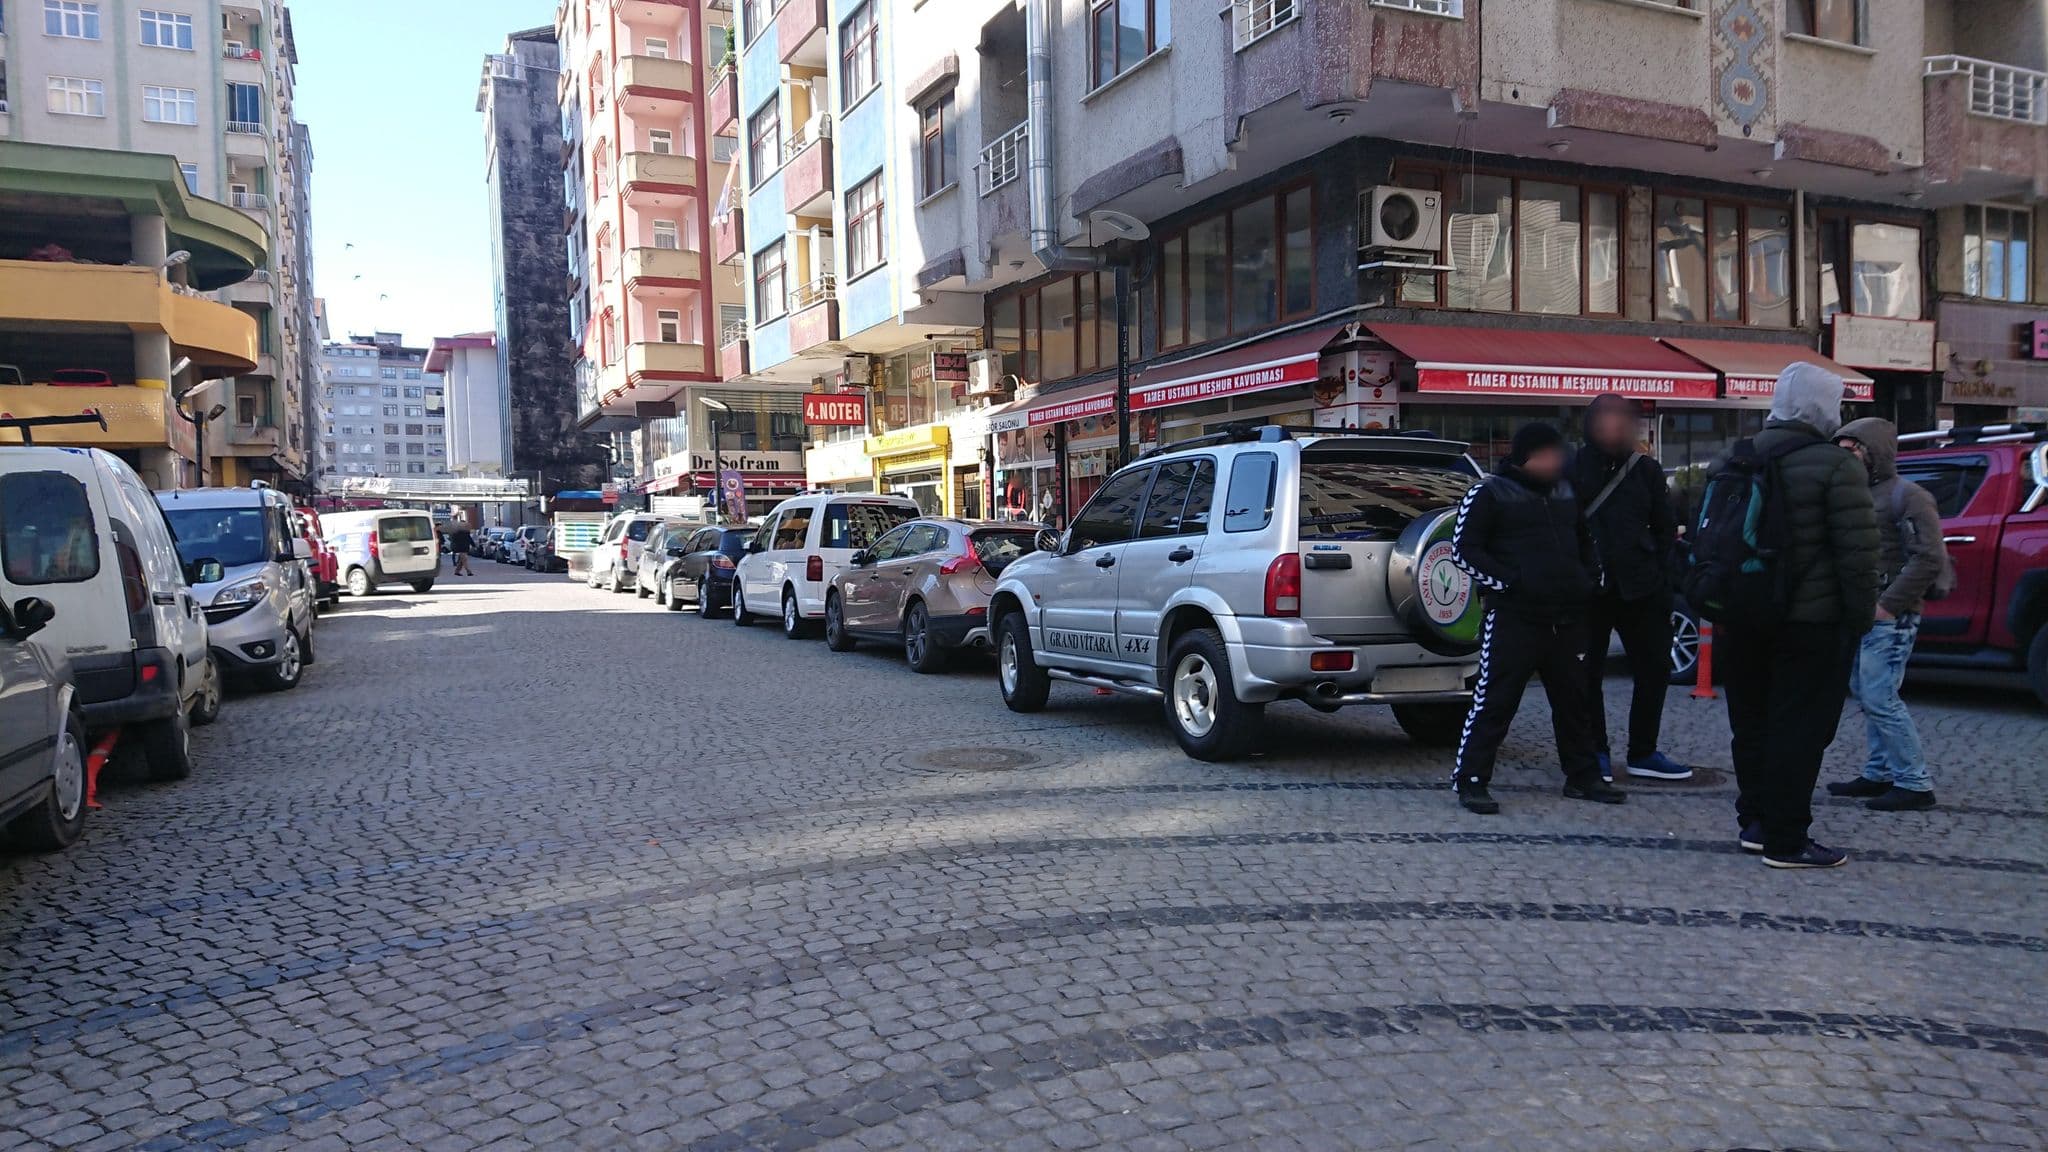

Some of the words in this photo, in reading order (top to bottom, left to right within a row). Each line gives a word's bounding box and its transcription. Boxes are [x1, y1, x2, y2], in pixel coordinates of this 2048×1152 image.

[1143, 391, 1166, 403] TAMER
[1167, 384, 1198, 399] USTANIN
[1199, 378, 1232, 396] MEŞHUR
[1234, 368, 1284, 388] KAVURMASI
[1467, 372, 1507, 387] TAMER
[1510, 374, 1559, 389] USTANIN
[1562, 376, 1609, 393] MEŞHUR
[1612, 379, 1674, 393] KAVURMASI
[1730, 379, 1757, 391] TAMER
[806, 402, 862, 421] 4.NOTER
[1029, 411, 1045, 422] TAMER
[692, 455, 713, 470] Dr
[719, 455, 780, 470] Sofram
[1049, 631, 1079, 649] GRAND
[1124, 638, 1150, 653] 4X4
